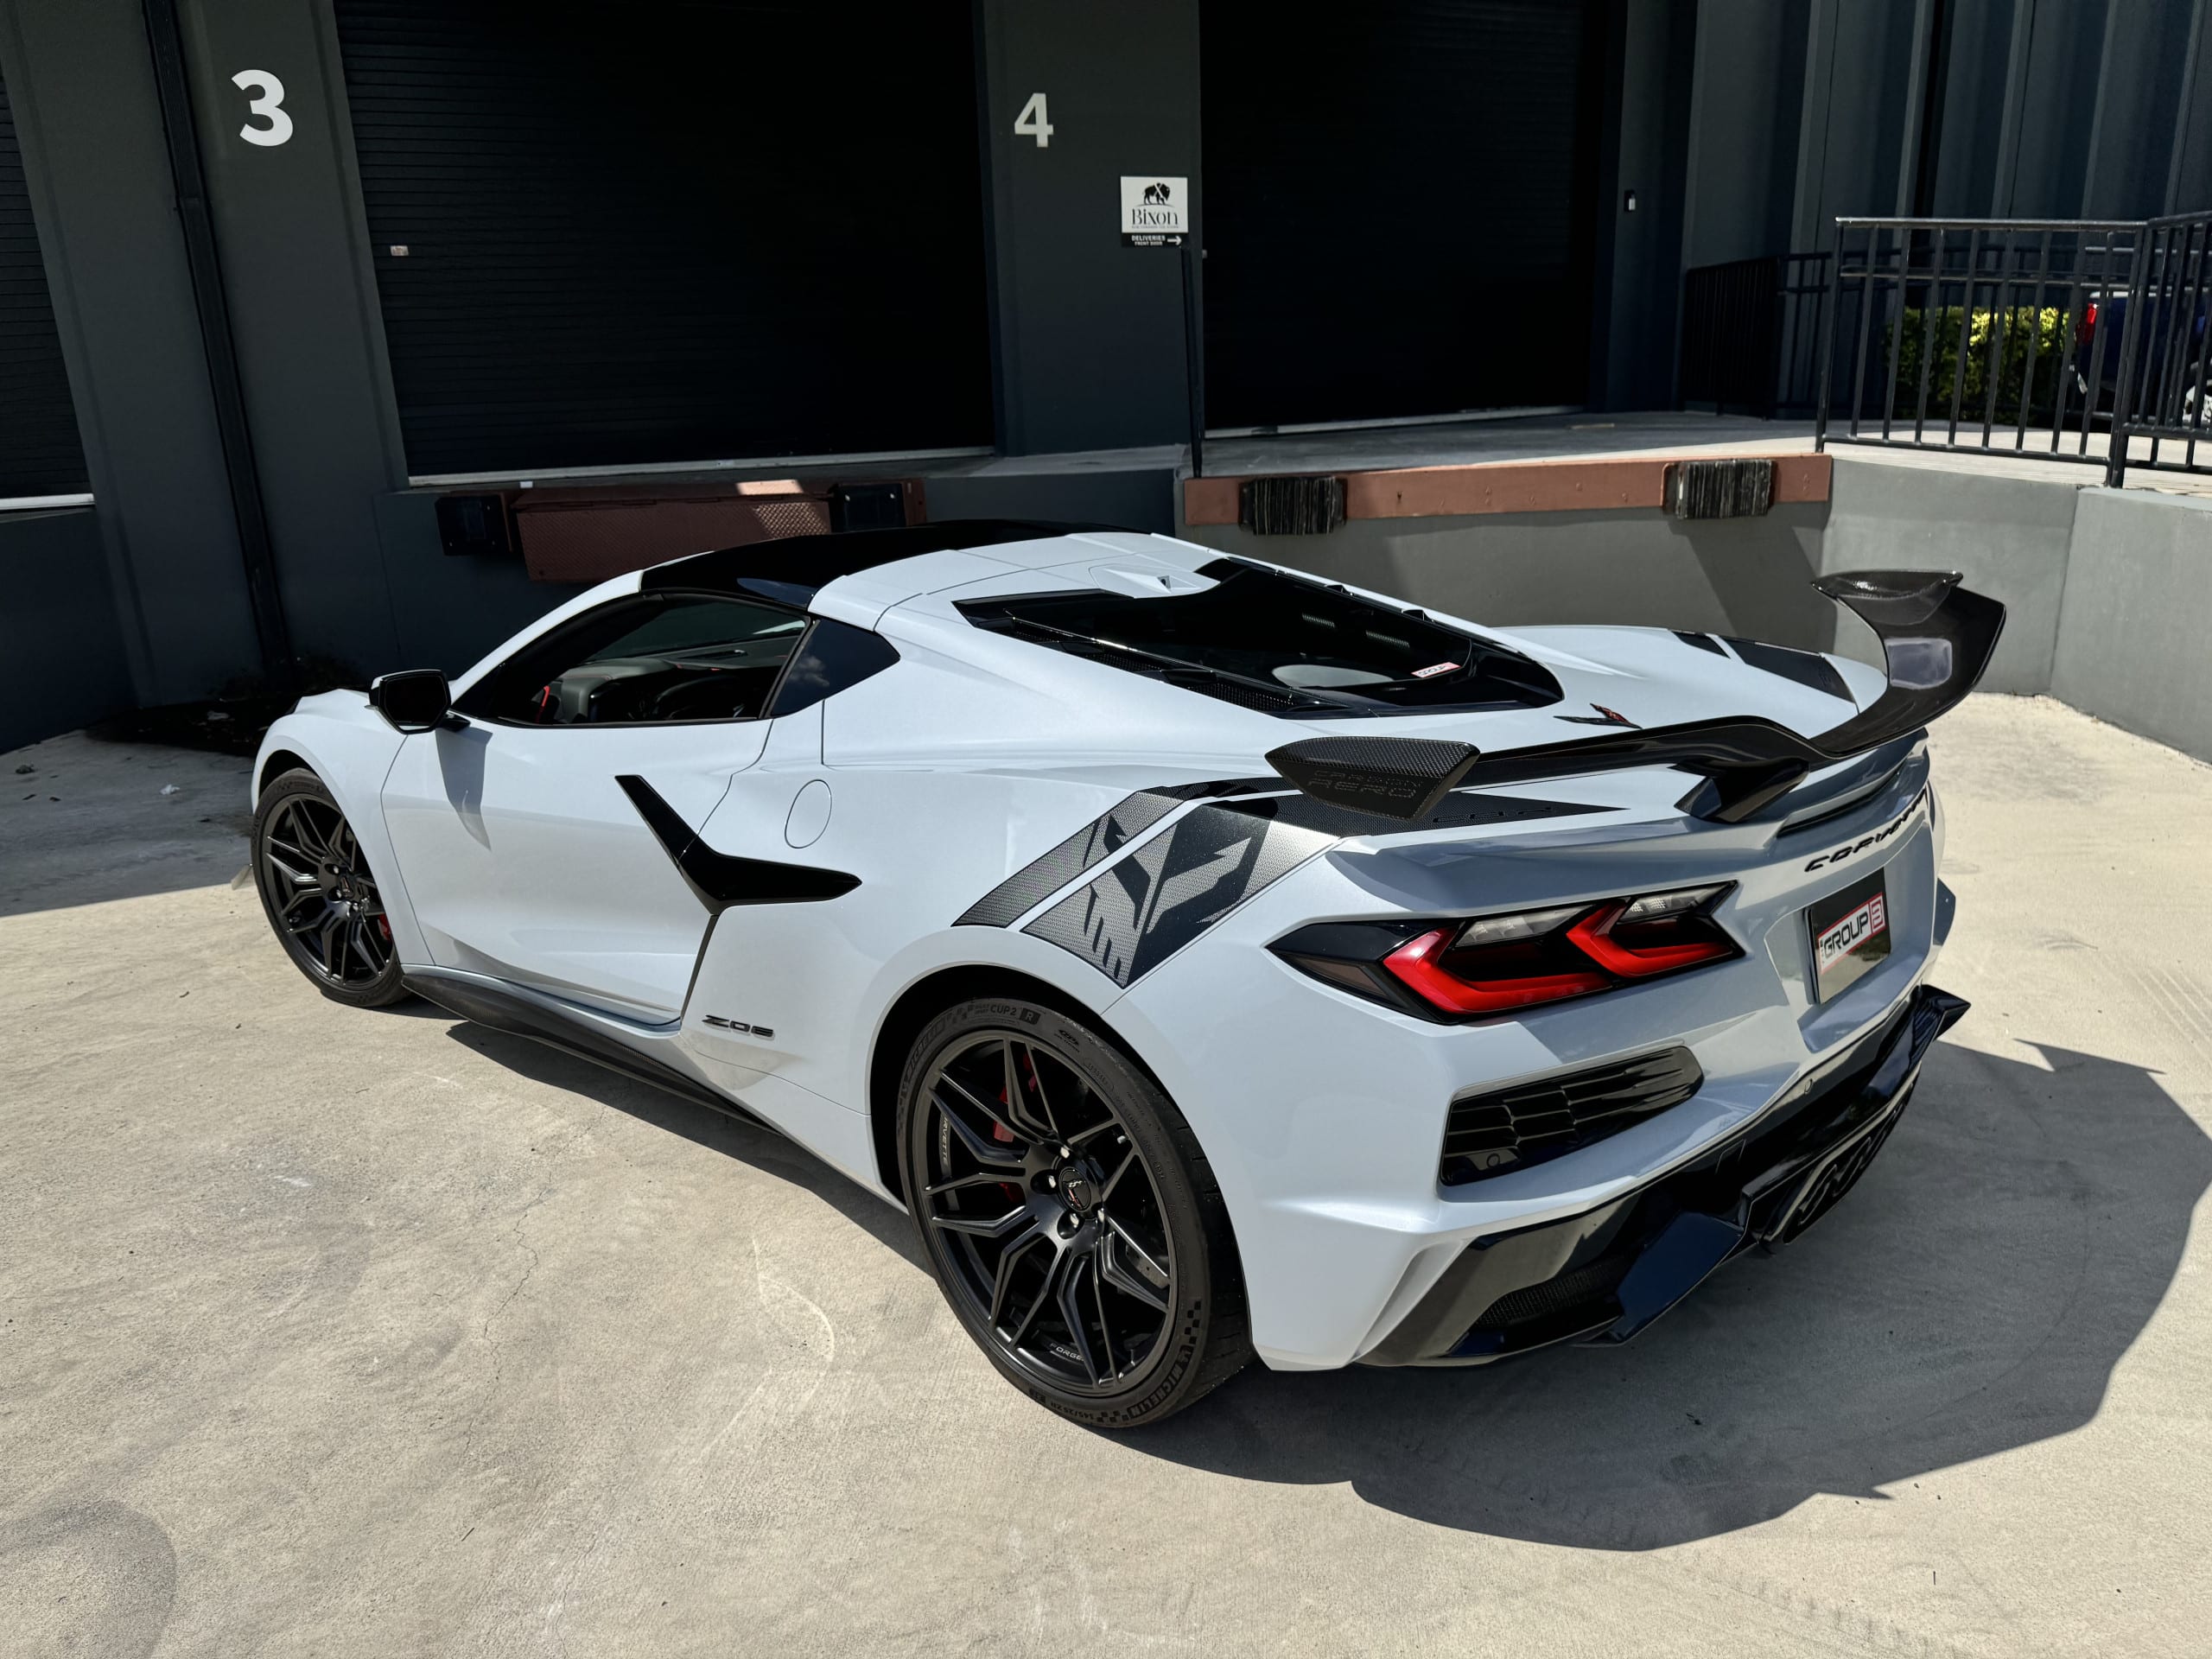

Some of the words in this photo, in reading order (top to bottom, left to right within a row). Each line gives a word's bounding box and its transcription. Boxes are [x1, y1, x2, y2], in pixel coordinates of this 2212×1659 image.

[231, 69, 294, 147] 3
[1014, 92, 1054, 148] 4
[1132, 208, 1178, 226] Bixon
[1307, 779, 1417, 799] AERO
[1823, 911, 1869, 959] GROUP
[990, 1004, 1011, 1014] CUP
[1010, 1007, 1018, 1016] 2
[1050, 1342, 1085, 1363] FORGE
[1128, 1363, 1185, 1419] MICHELIN
